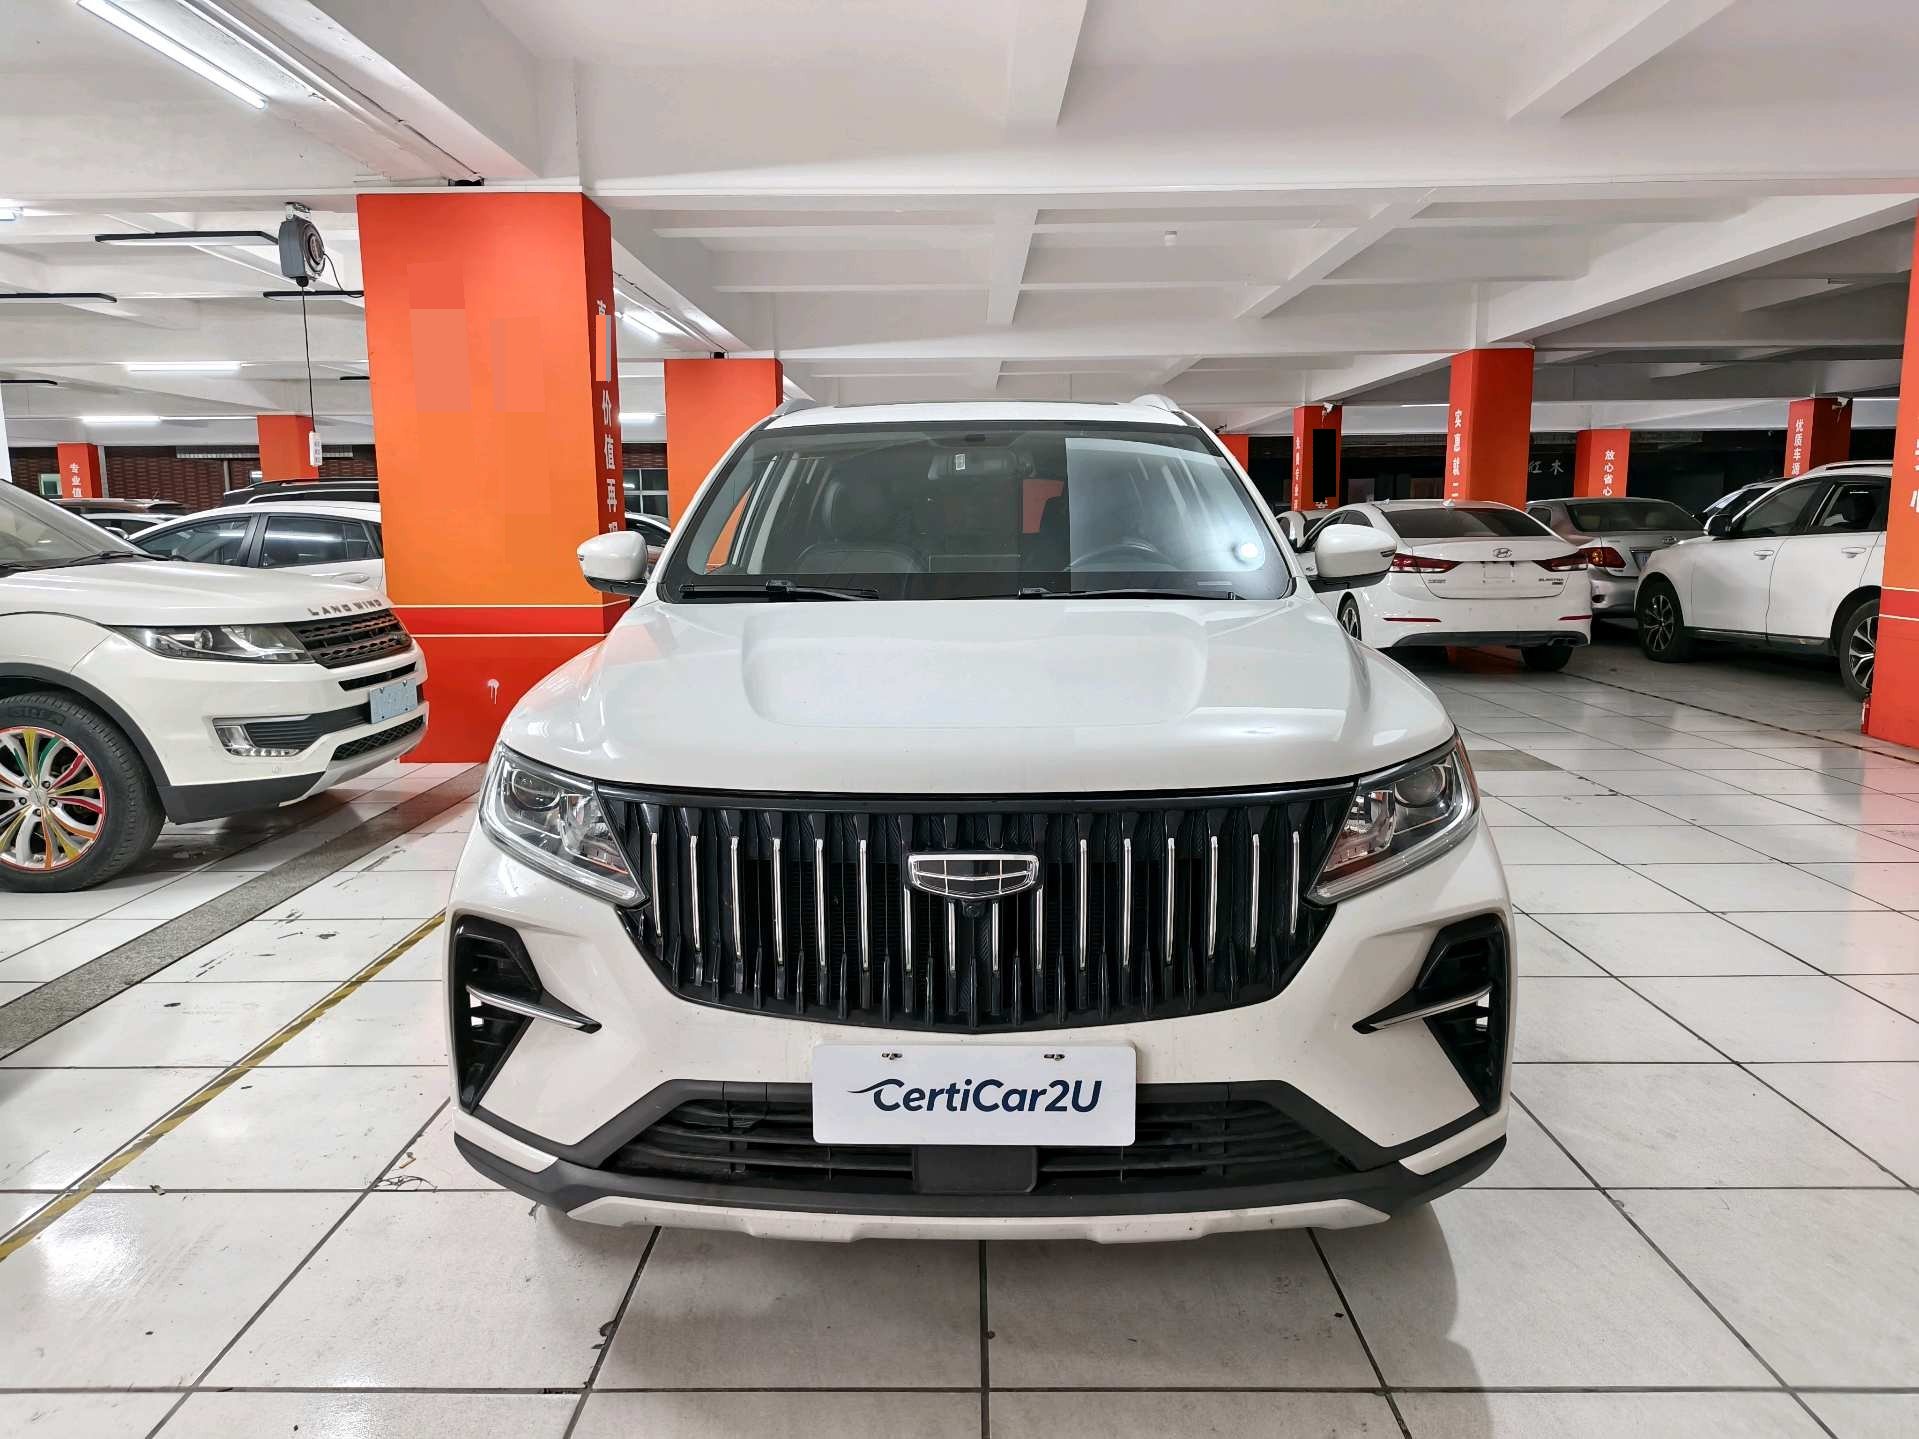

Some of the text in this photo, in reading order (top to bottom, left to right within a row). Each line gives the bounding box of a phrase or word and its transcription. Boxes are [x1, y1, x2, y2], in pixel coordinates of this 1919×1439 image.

[1791, 418, 1805, 477] 优质车源
[1603, 449, 1616, 497] 放心省心
[848, 1078, 1103, 1113] CertiCar2U
